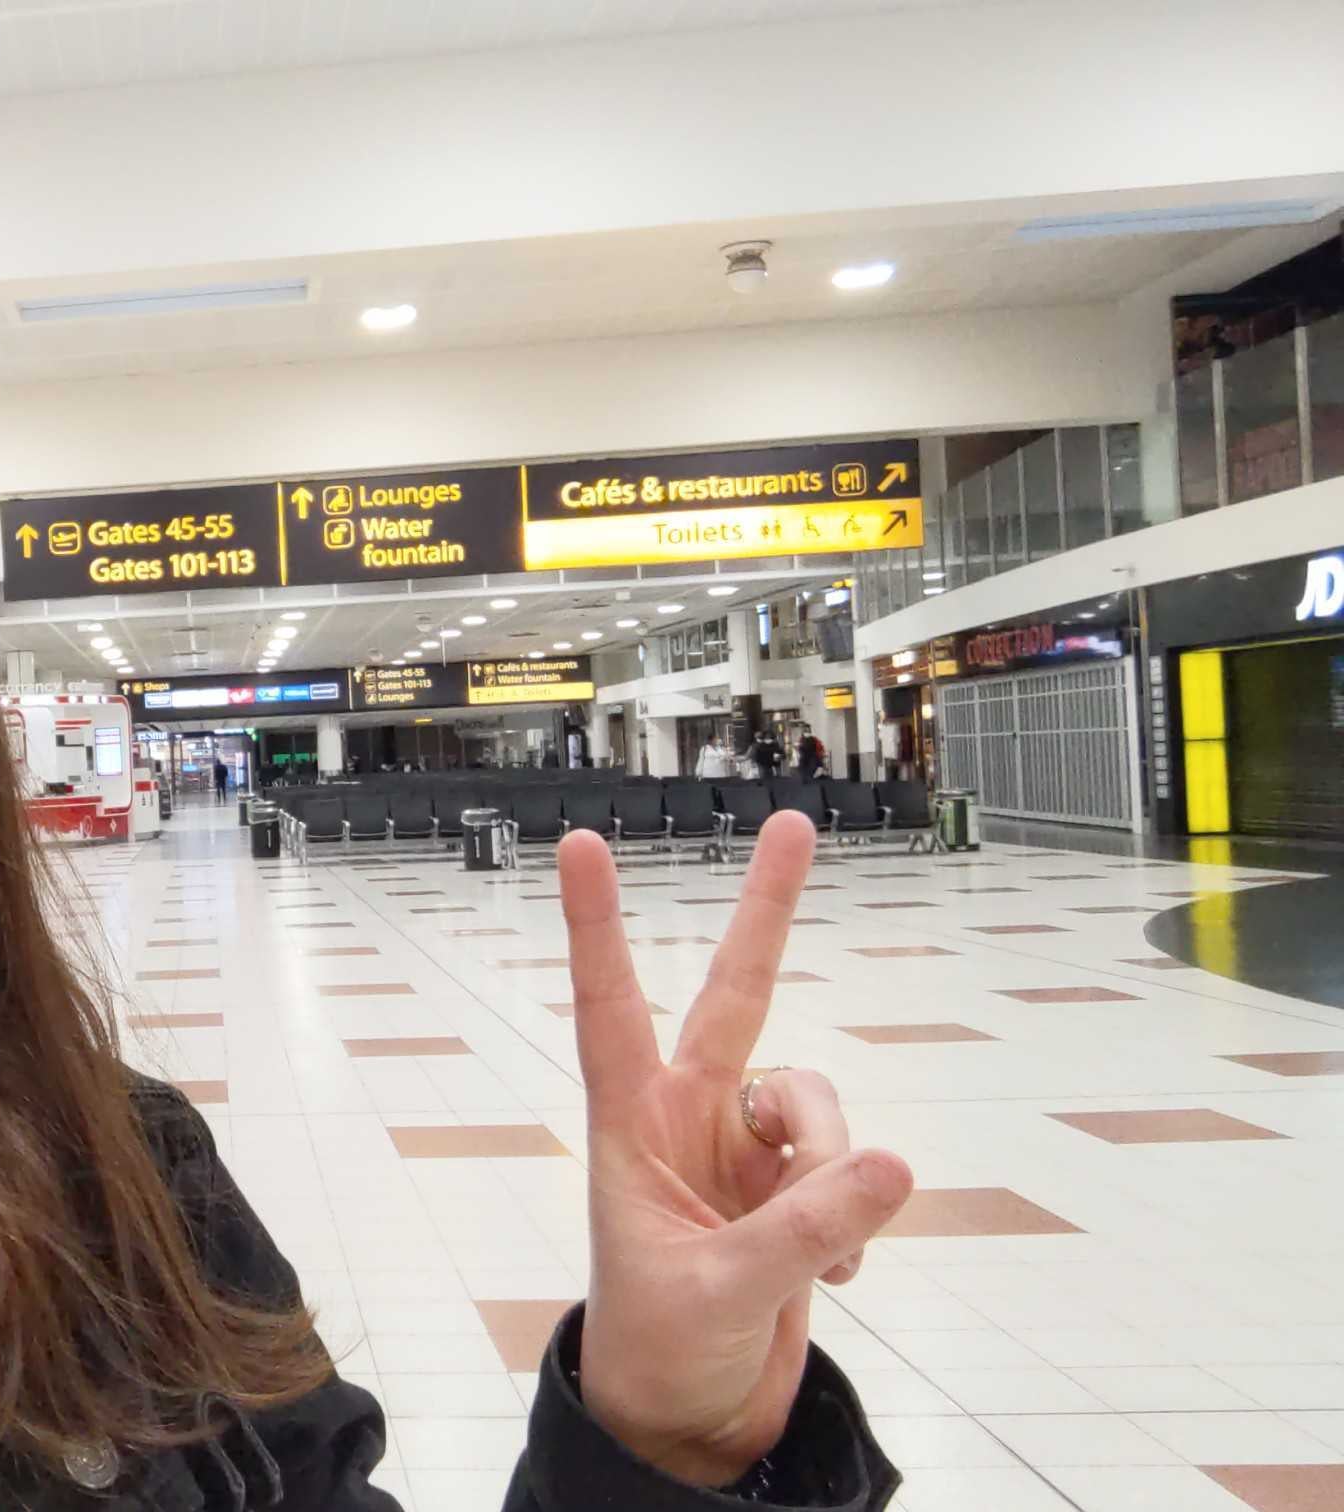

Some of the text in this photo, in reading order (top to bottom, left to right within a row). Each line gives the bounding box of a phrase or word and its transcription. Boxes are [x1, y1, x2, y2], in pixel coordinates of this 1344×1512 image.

[359, 483, 462, 509] Lounges
[561, 470, 823, 509] Cafés & restaurants
[88, 514, 234, 545] Gates 45-55
[360, 517, 433, 540] Water
[653, 518, 744, 545] Toilets
[89, 549, 256, 583] Gates 101-113
[362, 540, 465, 567] fountain
[1296, 556, 1344, 621] JD
[377, 670, 402, 679] Gates
[530, 660, 578, 670] restaurants
[378, 681, 403, 690] Gates
[498, 673, 561, 684] Water fountain
[378, 693, 414, 702] Lounges
